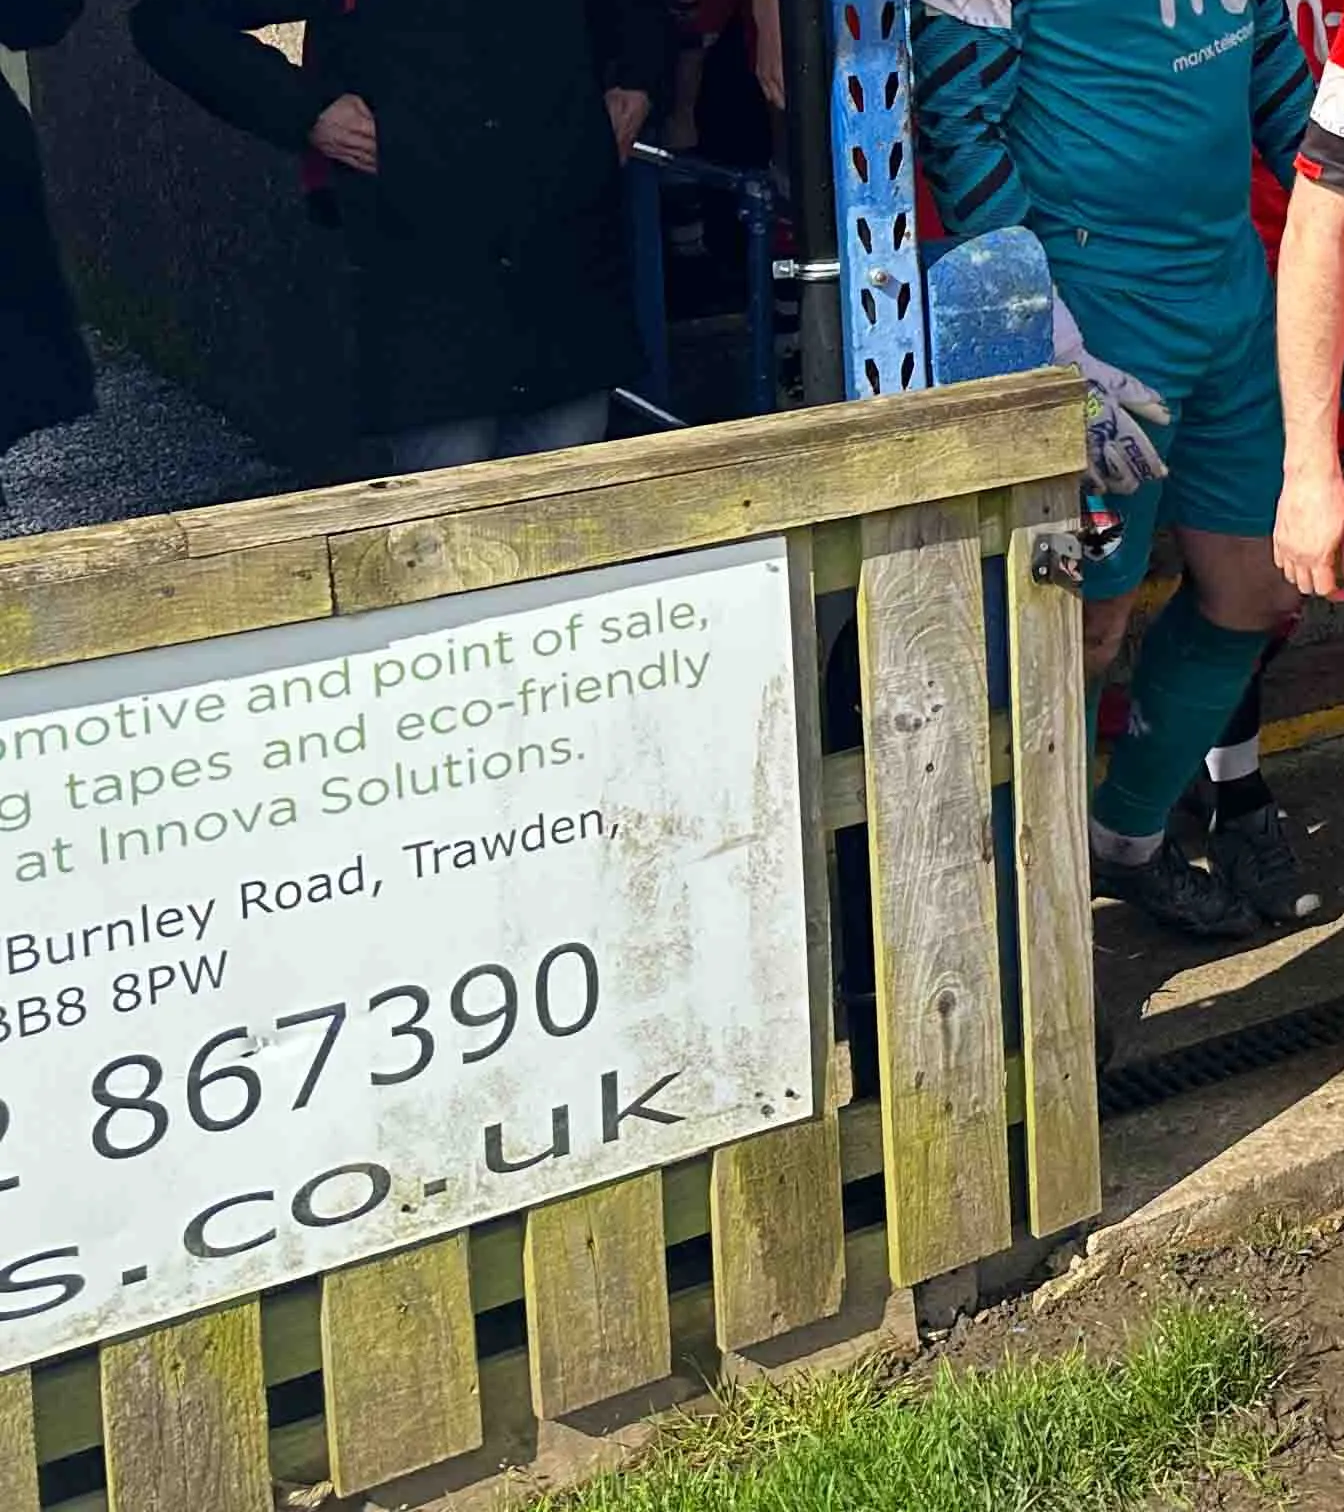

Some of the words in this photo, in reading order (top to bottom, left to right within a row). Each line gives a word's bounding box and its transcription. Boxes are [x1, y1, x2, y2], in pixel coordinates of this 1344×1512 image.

[1173, 45, 1215, 72] manx
[0, 694, 226, 760] motive
[246, 657, 352, 716] and
[372, 629, 514, 700] point
[532, 613, 584, 658] of
[600, 598, 711, 649] sale,
[65, 751, 232, 810] tapes
[263, 714, 367, 770] and
[395, 650, 711, 743] eco-friendly
[15, 837, 74, 882] at
[100, 794, 298, 864] Innova
[320, 731, 587, 816] Solutions.
[7, 898, 216, 975] Burnley
[239, 857, 383, 920] Road,
[402, 807, 620, 880] Trawden,
[91, 941, 600, 1159] 867390
[112, 950, 227, 1013] 8PW
